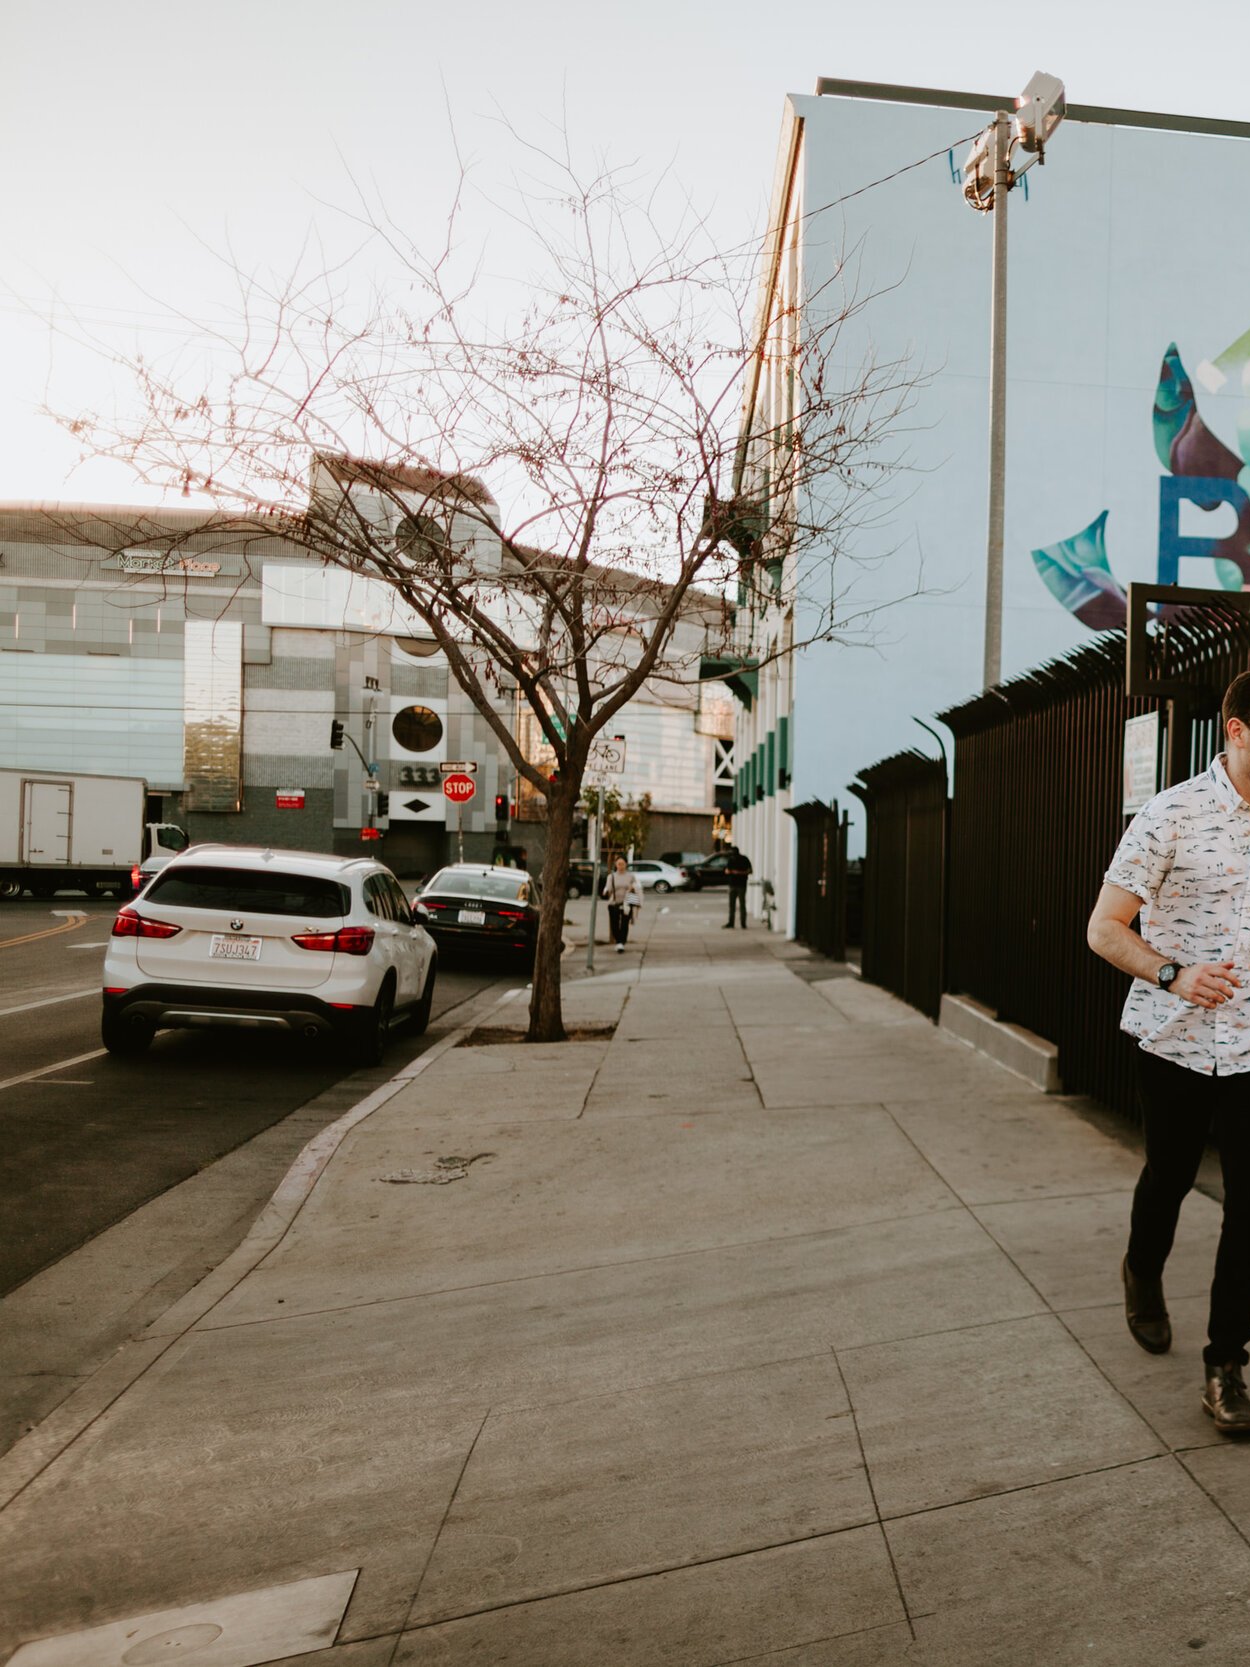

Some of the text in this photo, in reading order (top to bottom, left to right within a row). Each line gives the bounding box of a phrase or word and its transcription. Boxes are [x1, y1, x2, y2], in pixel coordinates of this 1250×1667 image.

[400, 766, 441, 787] 333
[446, 782, 473, 795] STOP
[215, 943, 257, 956] 7SUJ347
